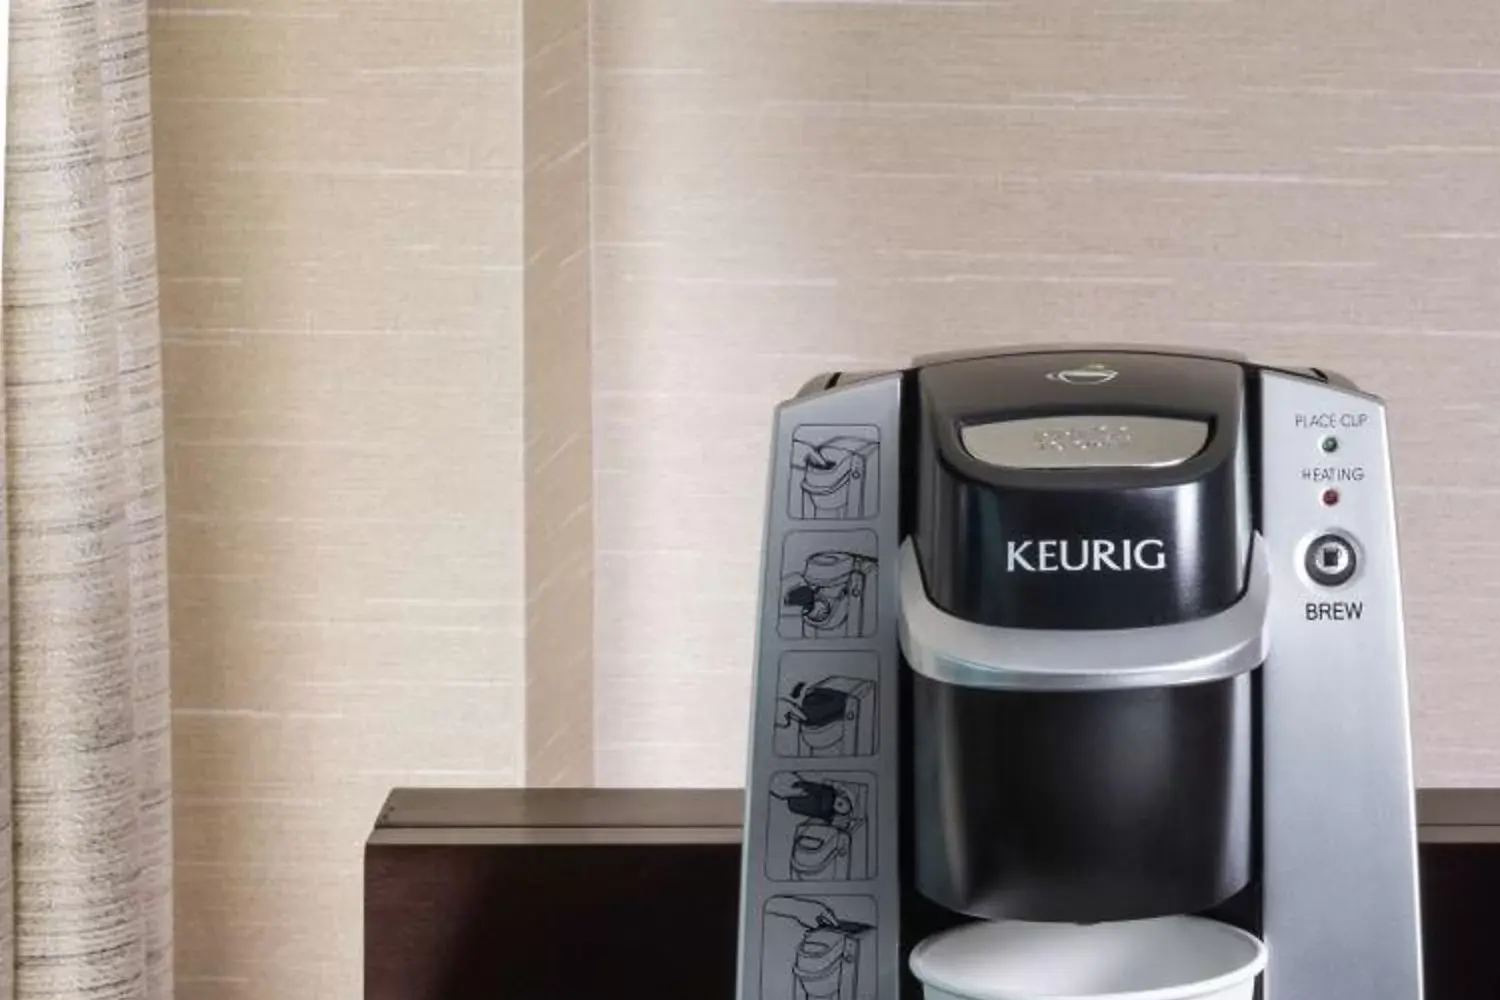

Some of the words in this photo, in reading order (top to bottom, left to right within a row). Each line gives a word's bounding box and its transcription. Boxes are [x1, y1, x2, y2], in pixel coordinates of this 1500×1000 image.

[1295, 413, 1337, 427] PLACE
[1341, 413, 1368, 427] CUP
[1301, 468, 1365, 481] HEATING
[1006, 539, 1167, 572] KEURIG
[1305, 602, 1363, 621] BREW
